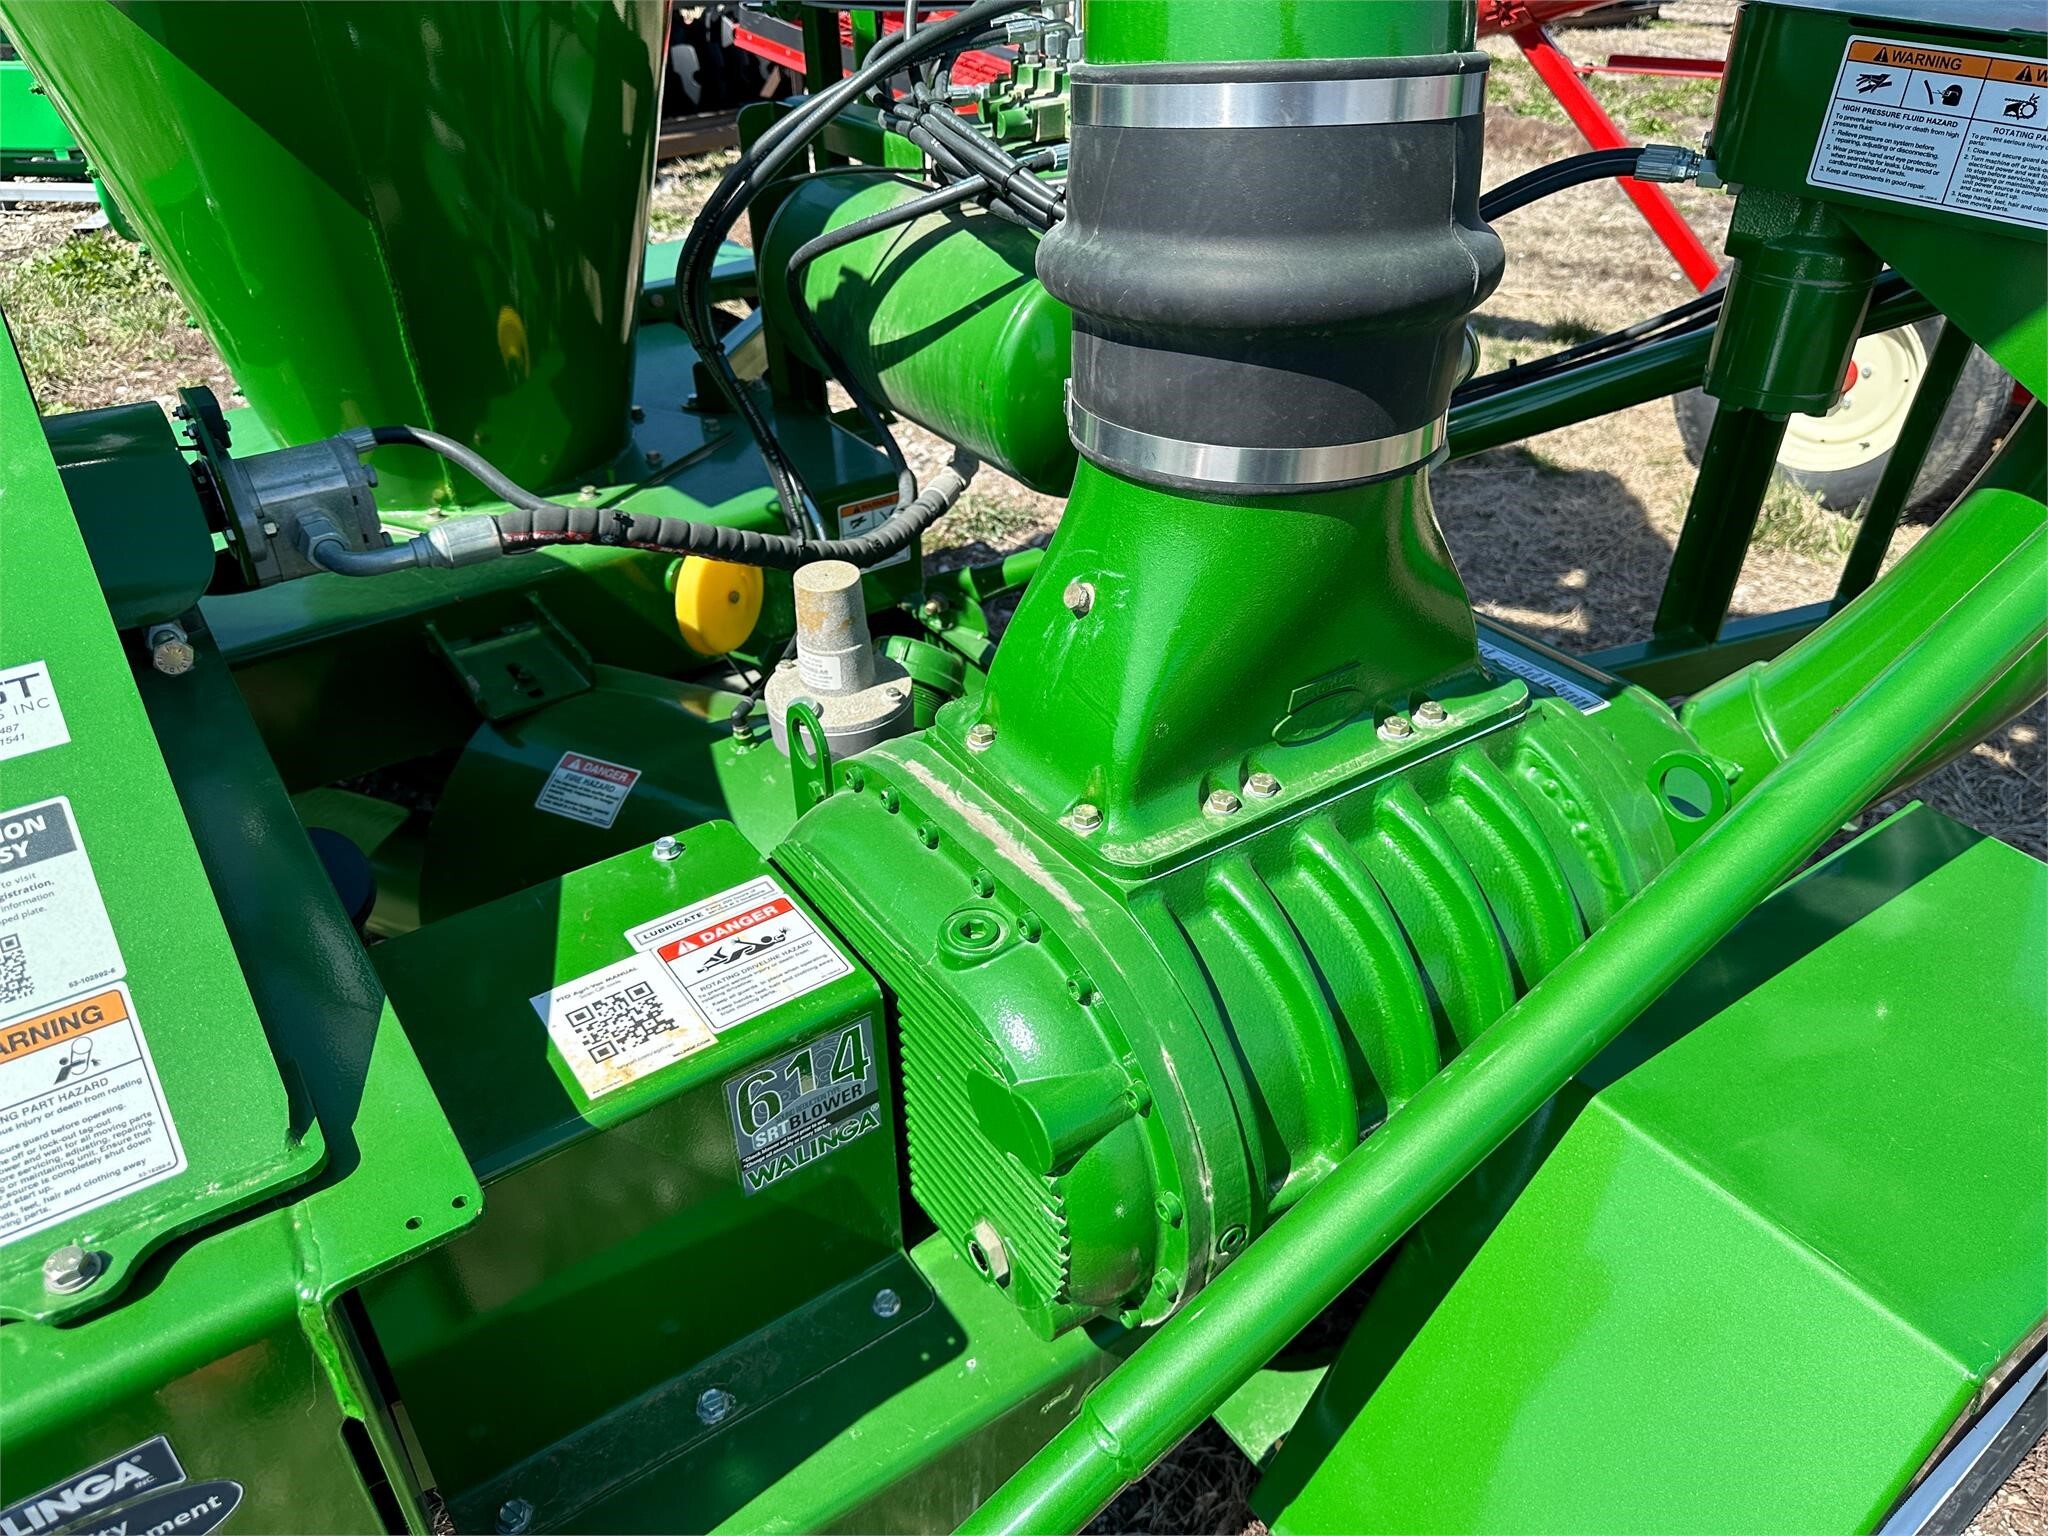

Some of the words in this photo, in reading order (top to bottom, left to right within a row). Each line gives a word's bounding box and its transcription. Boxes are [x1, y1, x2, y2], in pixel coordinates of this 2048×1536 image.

[1891, 48, 1963, 71] WARNING
[1831, 119, 1858, 129] pressure
[1857, 122, 1873, 132] fluid:
[1835, 112, 1844, 120] To
[1842, 114, 1866, 123] prevent
[1865, 118, 1887, 127] serious
[1886, 121, 1905, 130] injury
[1911, 124, 1930, 133] death
[1929, 127, 1945, 136] from
[1944, 129, 1960, 139] high
[1841, 103, 1861, 113] HIGH
[1860, 106, 1902, 119] PRESSURE
[1901, 112, 1925, 123] FLUID
[1924, 116, 1959, 128] HAZARD
[1836, 128, 1858, 138] Relieve
[1856, 133, 1884, 143] pressure
[1892, 139, 1915, 148] system
[1913, 141, 1935, 151] before
[1967, 138, 1985, 146] parts:
[1970, 131, 1980, 139] To
[1978, 134, 2003, 143] prevent
[2002, 138, 2026, 147] serious
[2025, 141, 2045, 151] injury
[1991, 126, 2035, 140] ROTATING
[1824, 142, 1831, 150] 2.
[1832, 143, 1848, 153] Wear
[1846, 147, 1868, 156] proper
[1866, 150, 1884, 159] hand
[1905, 158, 1938, 168] protection
[1834, 136, 1861, 147] repairing,
[1861, 140, 1889, 152] adjusting
[1895, 146, 1939, 160] disconnecting.
[1971, 146, 1990, 155] Close
[2000, 152, 2022, 161] secure
[2021, 155, 2040, 164] guard
[1827, 158, 1858, 169] cardboard
[1856, 163, 1880, 173] instead
[1885, 167, 1906, 178] hands.
[1829, 151, 1846, 159] when
[1845, 154, 1875, 165] searching
[1883, 160, 1901, 169] leaks.
[1901, 163, 1914, 172] Use
[1914, 166, 1933, 175] wood
[1970, 154, 1984, 162] Turn
[1984, 157, 2010, 167] machine
[1824, 166, 1841, 175] Keep
[1847, 170, 1884, 183] components
[1890, 178, 1908, 187] good
[1906, 181, 1926, 190] repair.
[13, 698, 50, 715] INC
[0, 733, 24, 746] 1541
[562, 772, 583, 784] FIRE
[581, 778, 615, 793] HAZARD
[582, 761, 629, 782] DANGER
[13, 871, 36, 884] visit
[0, 890, 55, 913] information
[642, 911, 704, 939] LUBRICATE
[698, 905, 778, 943] DANGER
[698, 971, 740, 992] ROTATING
[739, 953, 780, 974] DRIVELINE
[780, 939, 813, 956] HAZARD
[734, 1022, 871, 1138] 614
[14, 1114, 42, 1130] injury
[43, 1110, 54, 1119] or
[55, 1099, 83, 1114] death
[83, 1090, 106, 1104] from
[106, 1076, 143, 1095] rotating
[21, 1096, 54, 1116] PART
[56, 1076, 109, 1103] HAZARD
[21, 1130, 49, 1148] guard
[49, 1119, 80, 1136] before
[80, 1102, 126, 1124] operating.
[10, 1150, 24, 1162] off
[25, 1146, 36, 1156] or
[37, 1130, 77, 1151] lock-out
[77, 1117, 111, 1135] tag-out
[16, 1155, 64, 1177] servicing,
[64, 1136, 111, 1158] adjusting,
[111, 1118, 156, 1139] repairing,
[23, 1152, 42, 1166] and
[42, 1144, 63, 1158] wait
[63, 1139, 78, 1149] for
[79, 1133, 91, 1144] all
[92, 1120, 127, 1138] moving
[128, 1110, 152, 1125] parts
[745, 1104, 880, 1191] WALINGA
[134, 1475, 157, 1489] INC.
